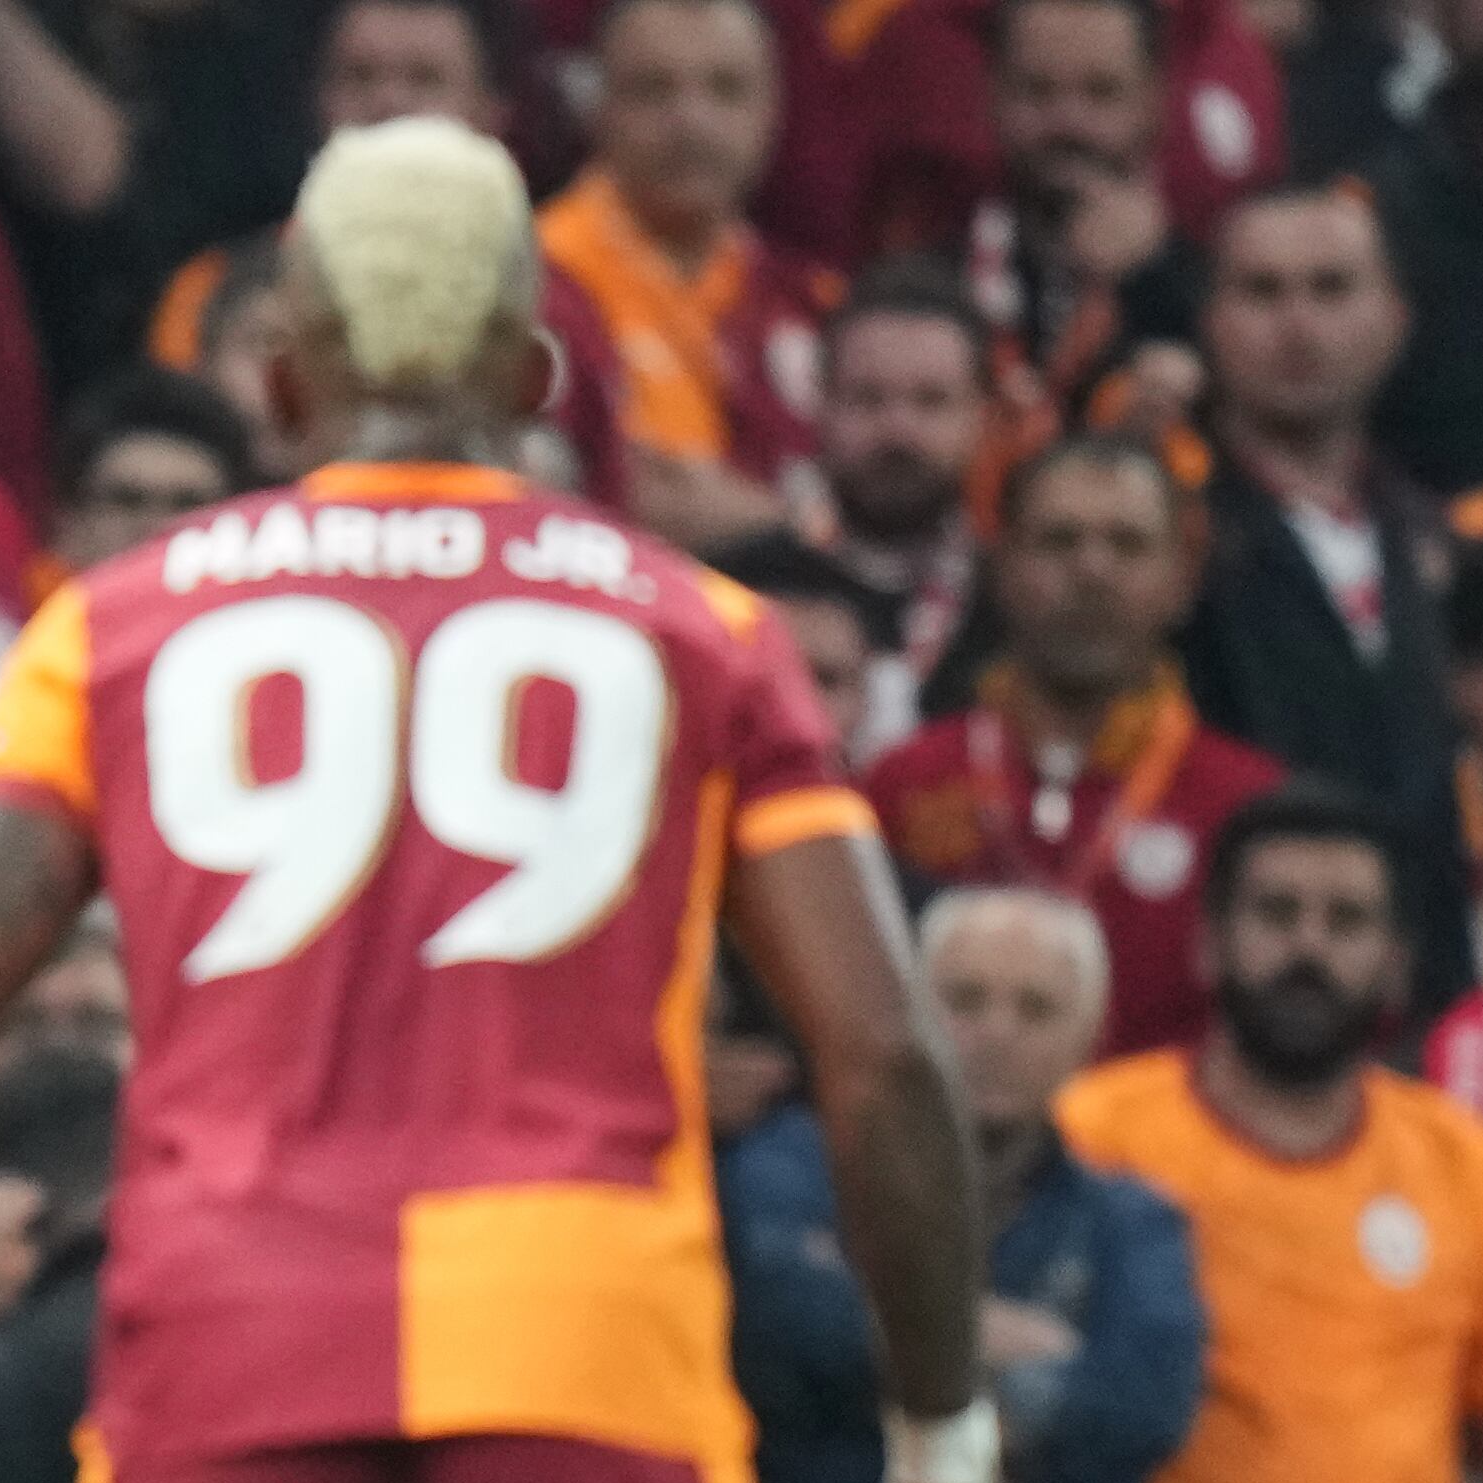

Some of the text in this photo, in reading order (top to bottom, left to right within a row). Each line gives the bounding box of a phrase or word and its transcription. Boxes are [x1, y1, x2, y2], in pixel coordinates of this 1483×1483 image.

[161, 502, 659, 605] MARIO JR.
[144, 595, 674, 983] 99
